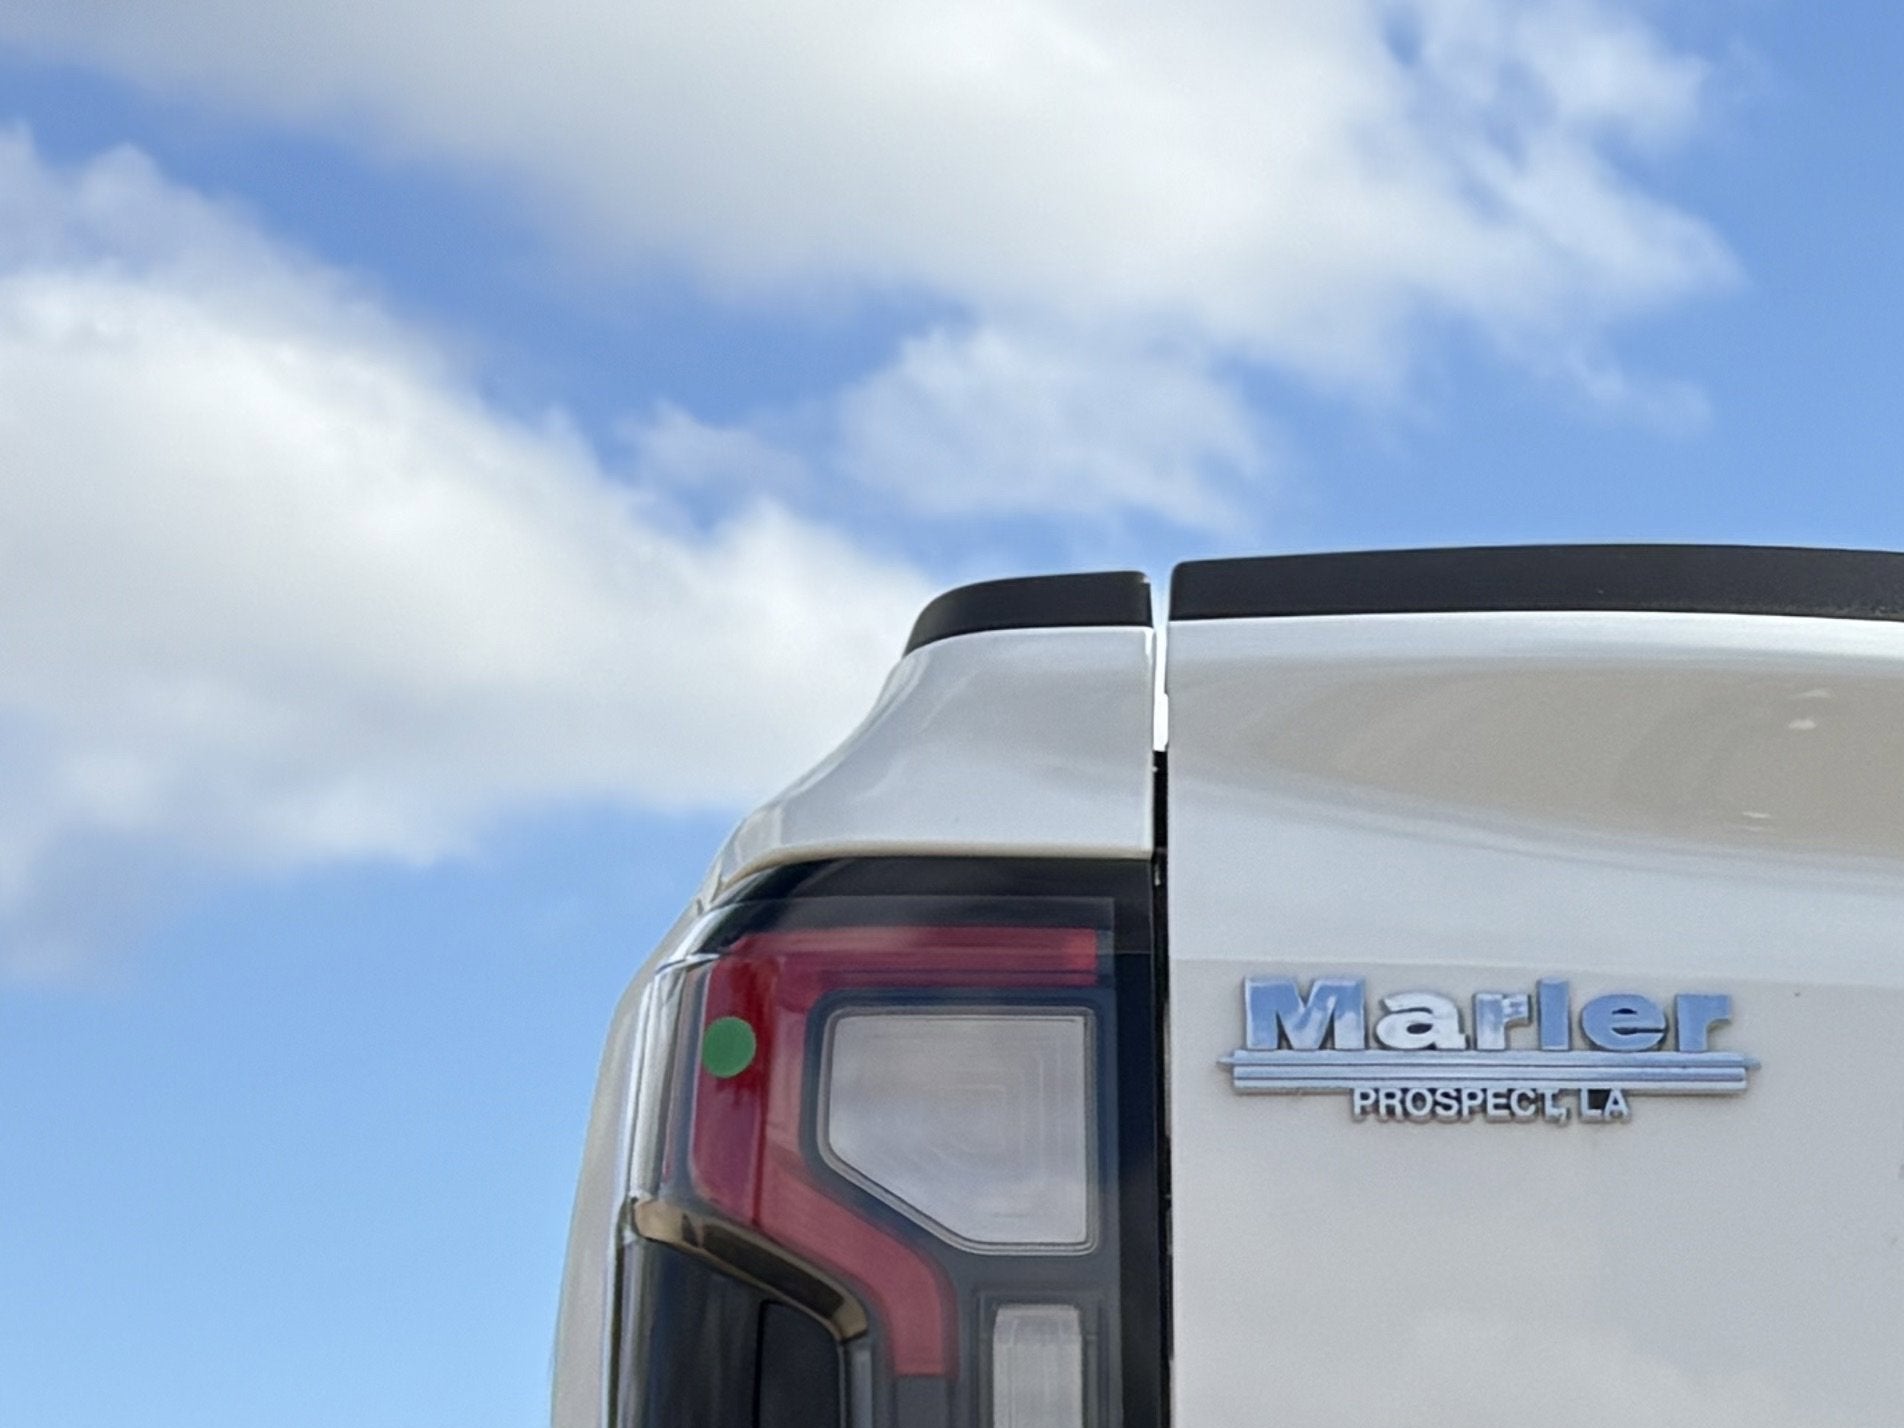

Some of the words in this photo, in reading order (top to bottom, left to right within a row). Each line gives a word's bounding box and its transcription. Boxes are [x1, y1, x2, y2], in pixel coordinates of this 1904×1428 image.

[1243, 975, 1732, 1053] Marler
[1353, 1086, 1570, 1123] PROSPECT,
[1579, 1086, 1630, 1120] LA
